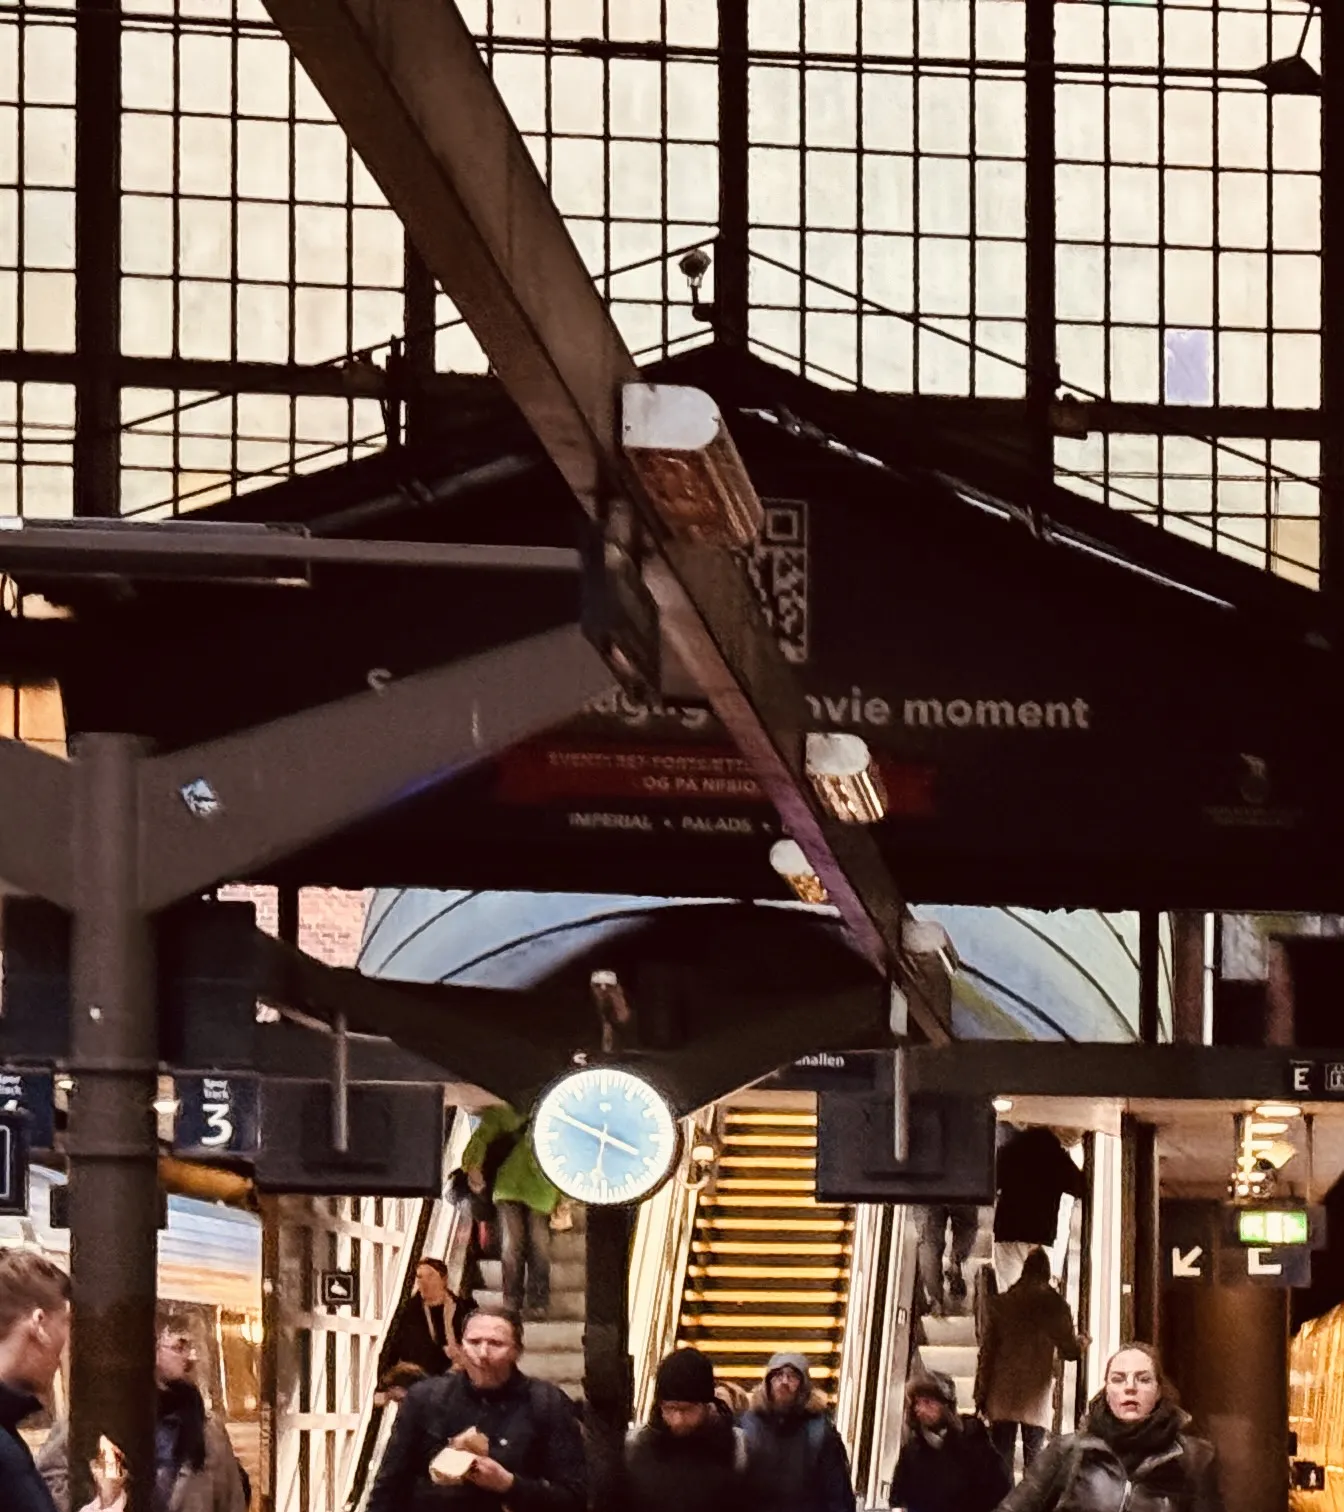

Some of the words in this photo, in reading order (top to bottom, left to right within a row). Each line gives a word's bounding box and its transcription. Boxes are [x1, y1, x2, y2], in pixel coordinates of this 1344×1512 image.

[904, 698, 1090, 729] moment
[1293, 1067, 1310, 1091] E
[201, 1103, 233, 1146] 3
